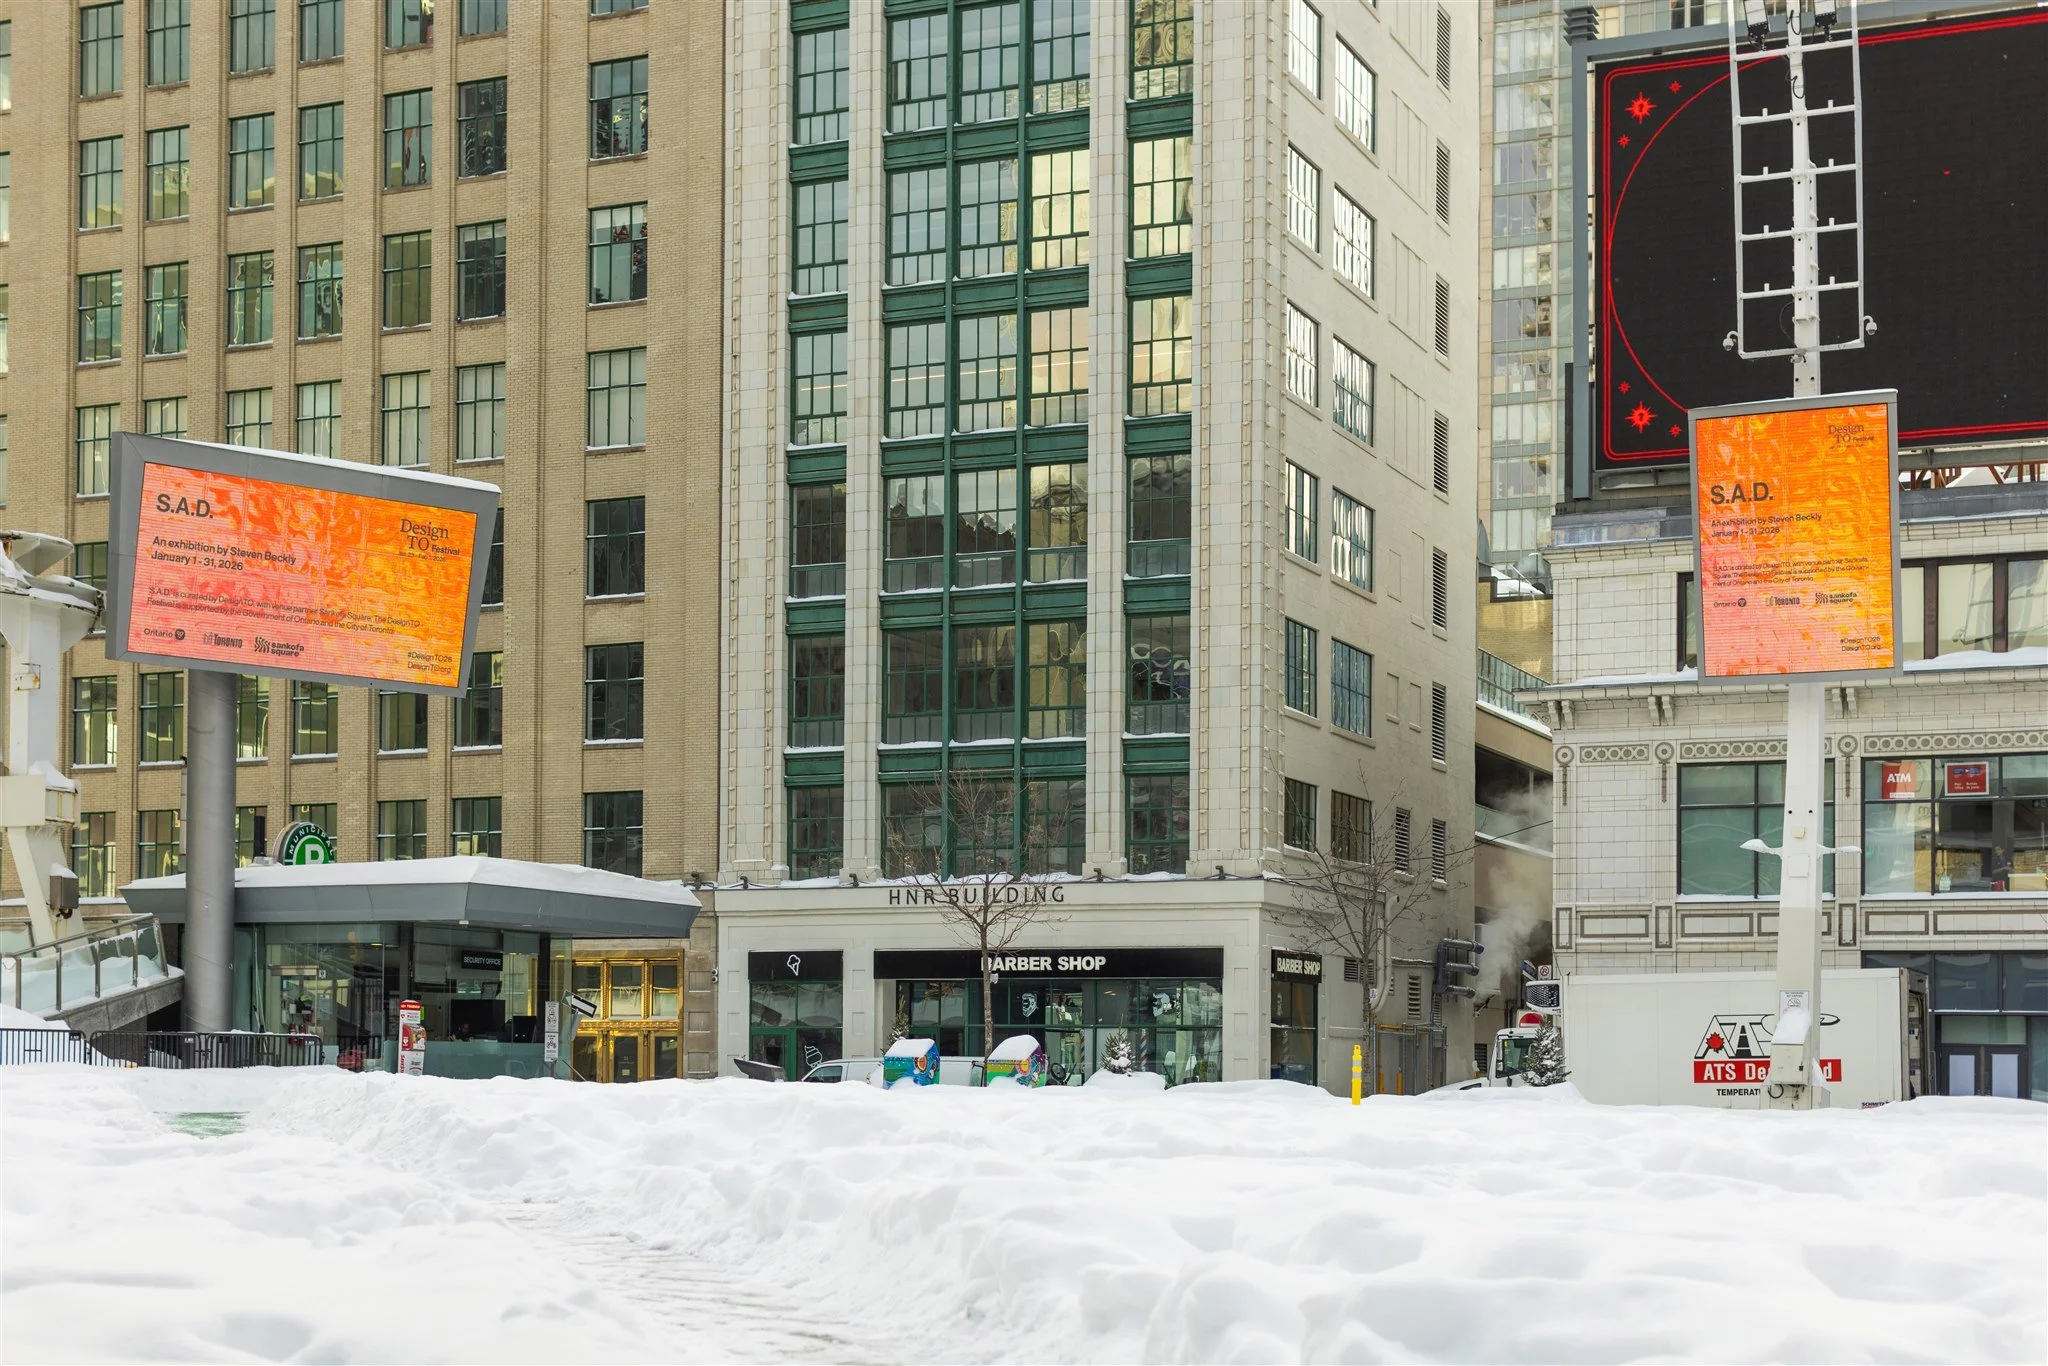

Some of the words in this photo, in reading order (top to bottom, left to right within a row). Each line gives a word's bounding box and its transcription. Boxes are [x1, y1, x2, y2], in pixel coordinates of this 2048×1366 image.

[1710, 482, 1774, 505] S.A.D.
[156, 493, 214, 519] S.A.D.
[400, 518, 449, 540] Design
[1758, 517, 1767, 525] by
[1768, 515, 1795, 523] Steven
[1711, 530, 1739, 538] January
[1760, 527, 1780, 535] 2026
[152, 536, 167, 547] An
[168, 539, 216, 553] exhibition
[216, 545, 229, 556] by
[229, 547, 263, 560] Steven
[264, 552, 296, 565] Beckly
[407, 535, 430, 551] TO
[431, 544, 460, 556] Festival
[151, 550, 190, 565] January
[192, 556, 197, 564] 1
[203, 557, 217, 568] 31,
[217, 559, 244, 571] 2026
[180, 591, 207, 600] curated
[208, 594, 217, 602] by
[257, 600, 271, 608] with
[147, 597, 175, 607] Festival
[182, 602, 220, 613] supported
[220, 606, 228, 615] by
[230, 606, 241, 615] the
[242, 607, 286, 621] Government
[294, 615, 319, 625] Ontario
[334, 620, 345, 629] the
[346, 621, 359, 631] City
[143, 628, 174, 638] Ontario
[213, 633, 243, 649] TORONTO
[270, 641, 305, 652] sankofa
[270, 648, 300, 657] square
[1886, 773, 1911, 784] ATM
[289, 826, 335, 856] MUNICIPAL
[888, 888, 935, 905] HNR
[949, 885, 1065, 905] BUILDING
[463, 956, 485, 964] SECURITY
[485, 958, 502, 966] OFFICE
[1057, 956, 1107, 971] SHOP
[1277, 957, 1303, 974] BARBER
[1303, 960, 1321, 976] SHOP
[1703, 1062, 1737, 1081] ATS
